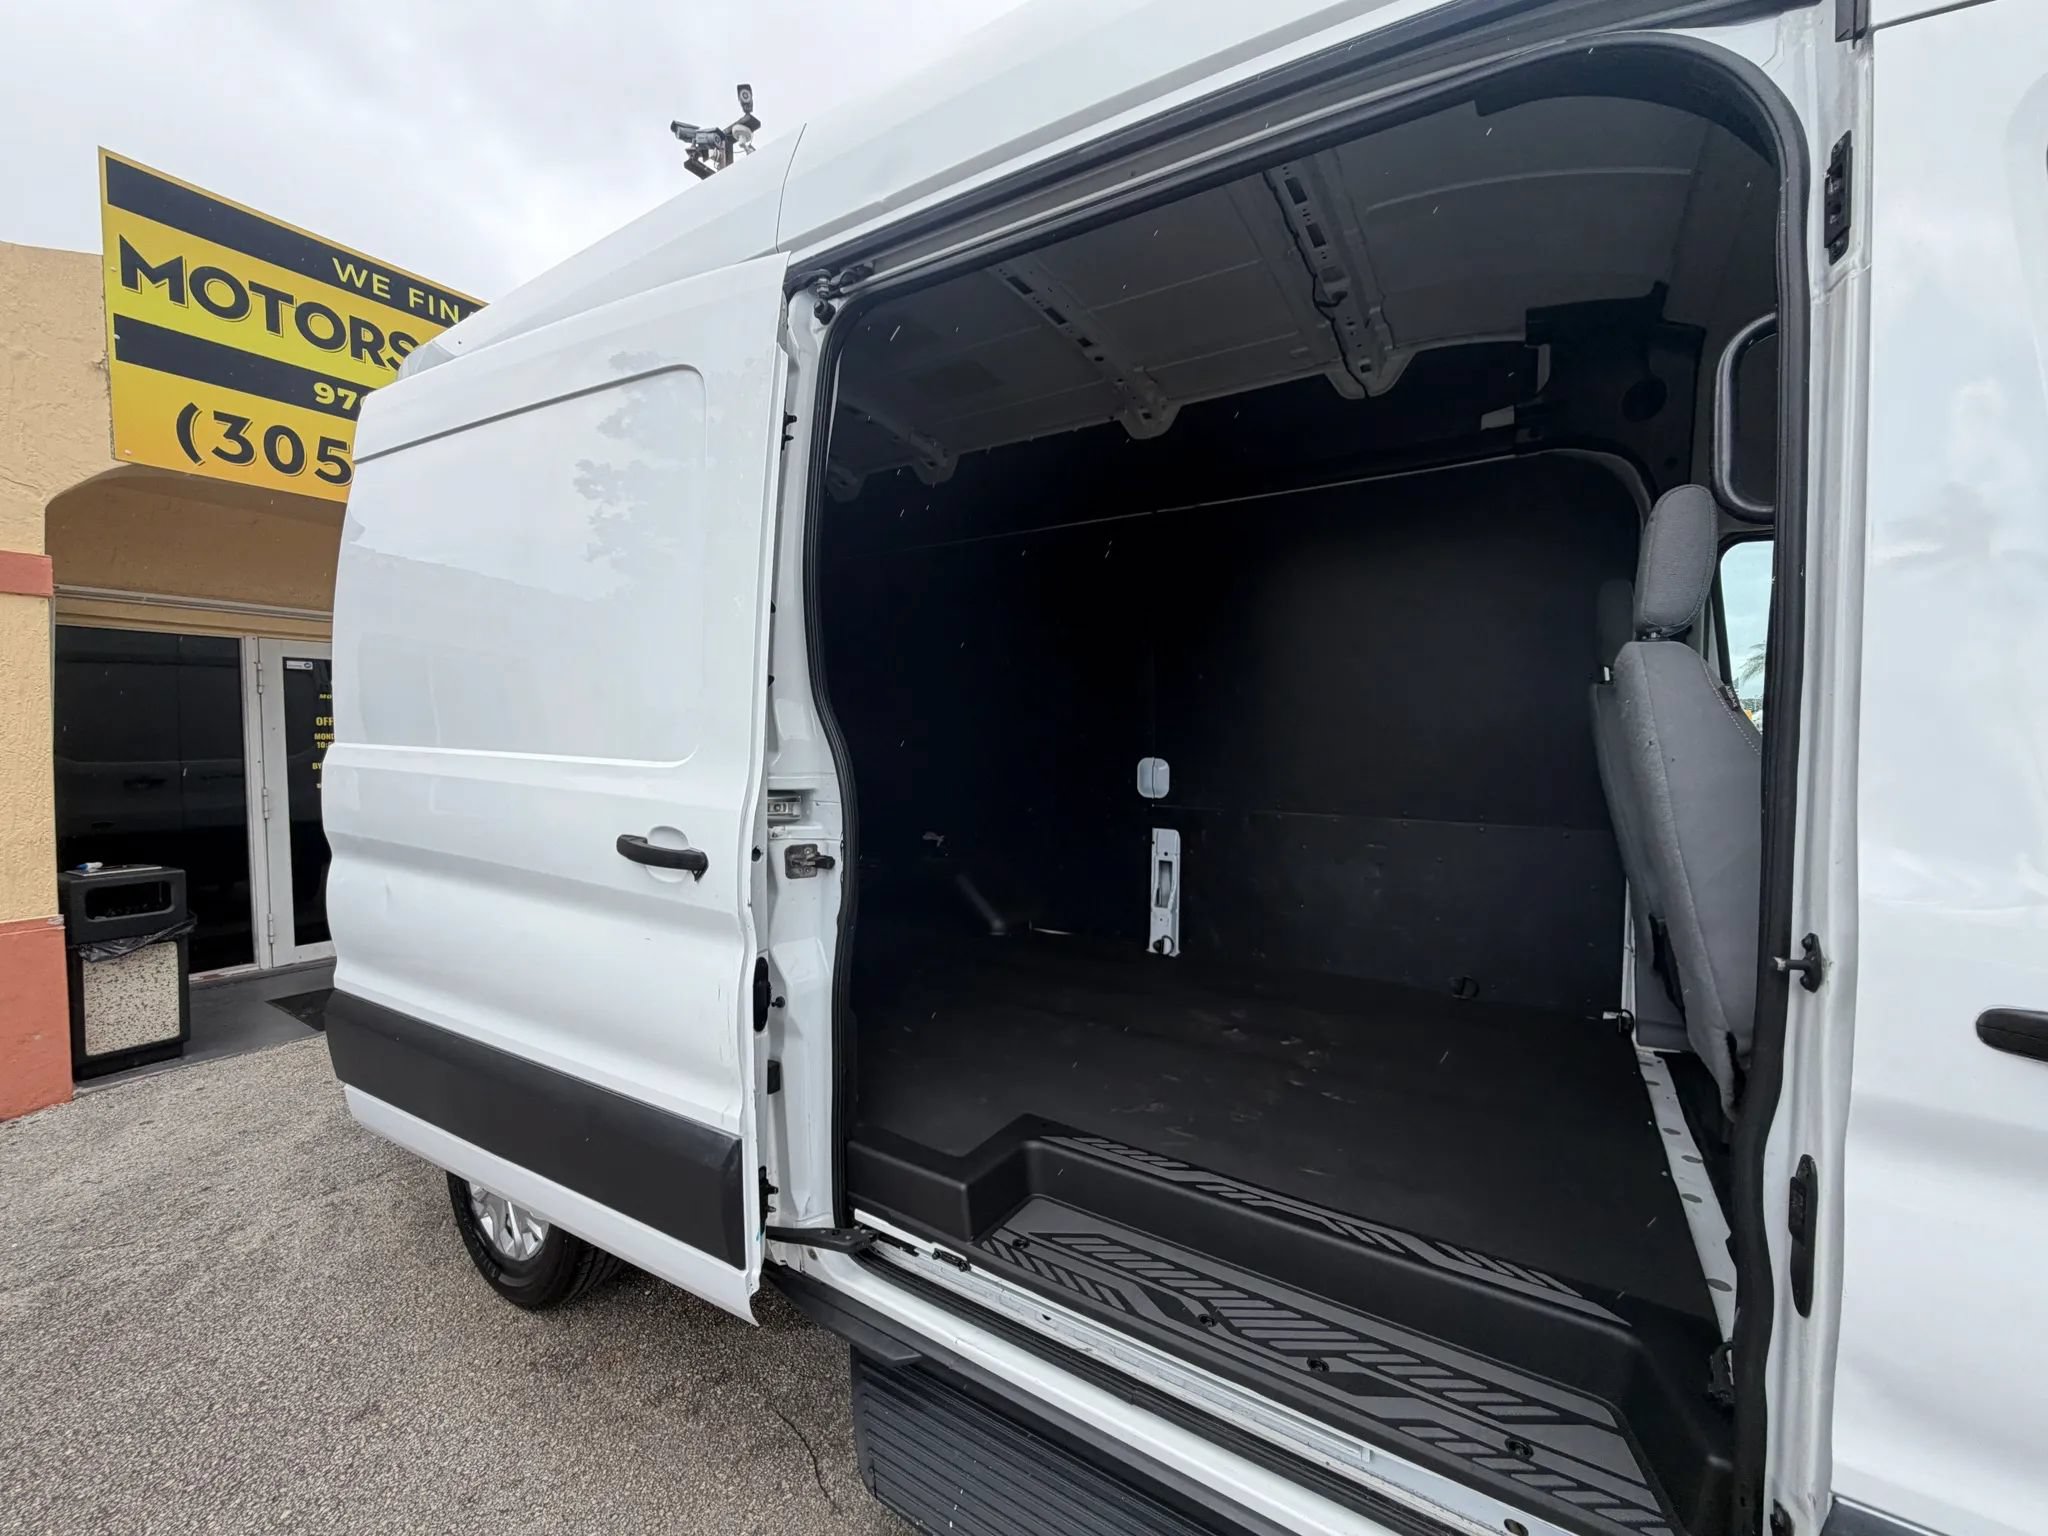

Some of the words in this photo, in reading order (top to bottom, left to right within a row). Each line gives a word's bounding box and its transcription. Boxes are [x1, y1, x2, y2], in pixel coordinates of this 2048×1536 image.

[119, 234, 420, 373] MOTORS
[332, 257, 391, 299] WE
[176, 402, 354, 487] (305
